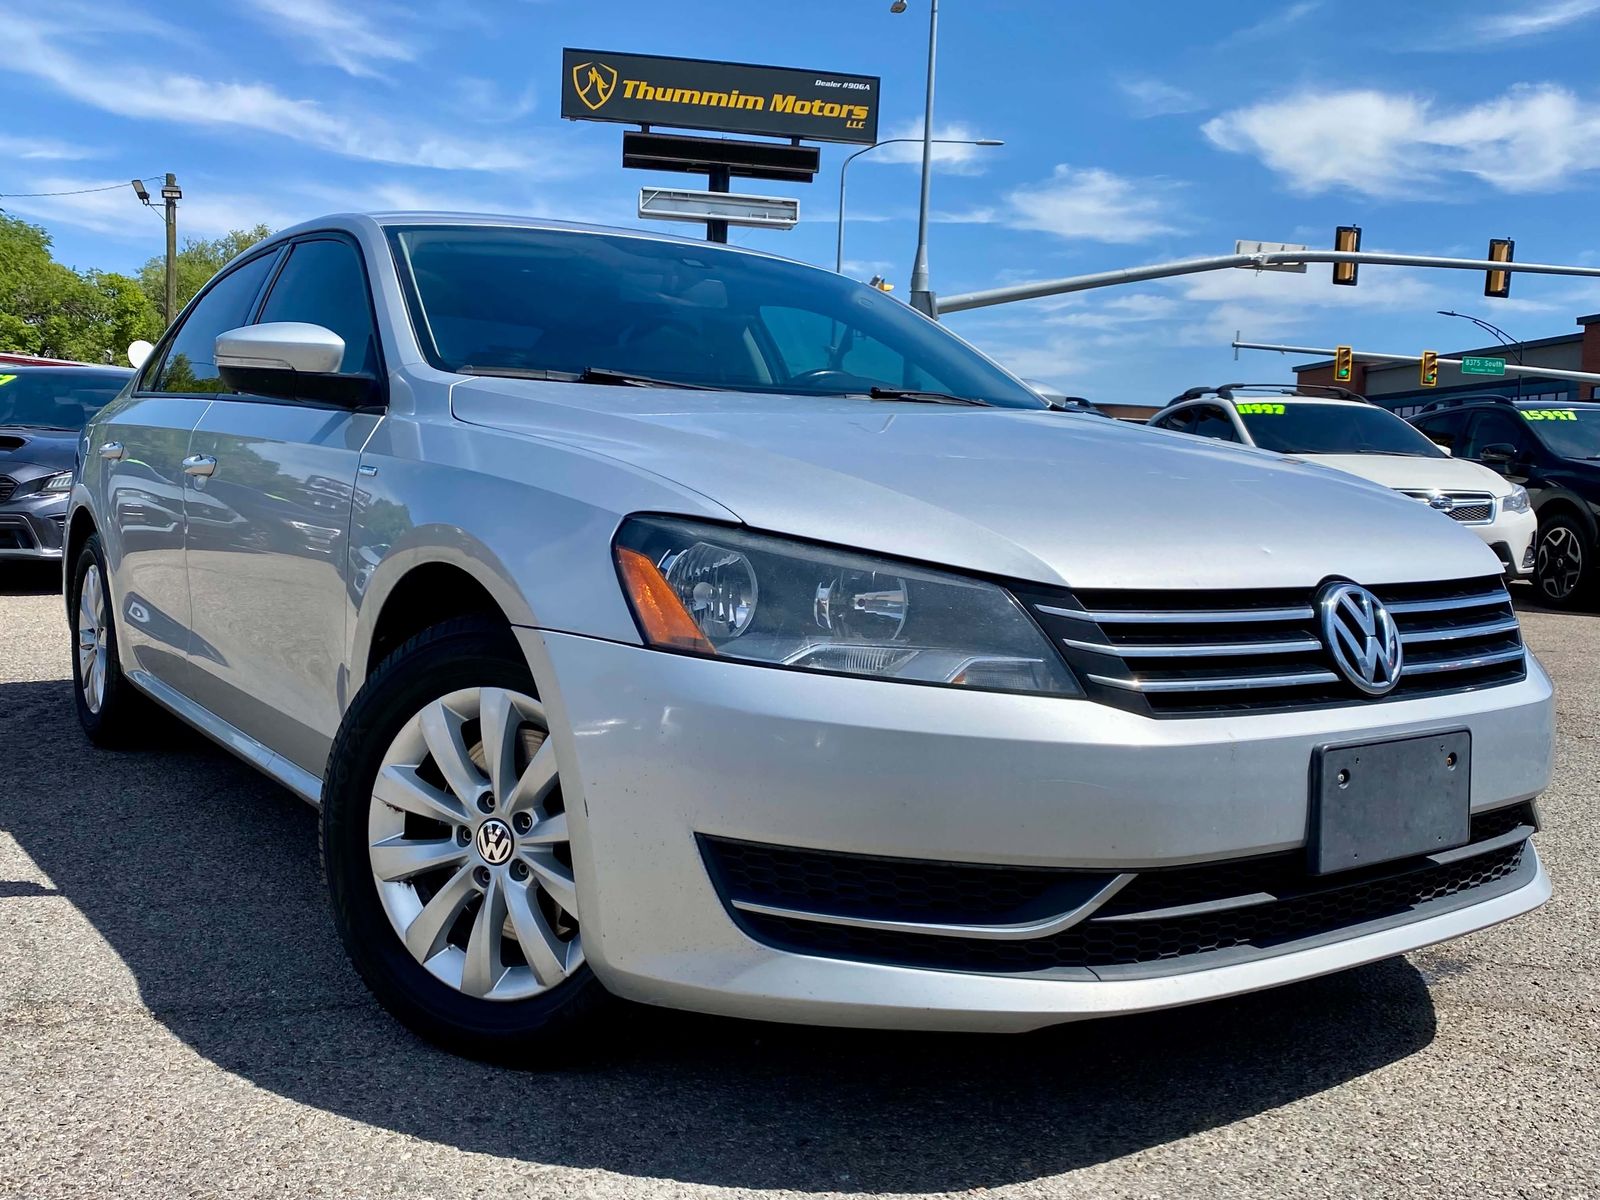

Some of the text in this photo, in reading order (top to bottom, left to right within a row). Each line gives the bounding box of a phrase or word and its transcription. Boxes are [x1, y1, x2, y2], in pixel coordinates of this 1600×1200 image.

[815, 79, 842, 88] Dealer
[623, 79, 869, 120] Thummim Motors
[846, 120, 865, 129] LLC
[1236, 404, 1285, 415] 11997
[1520, 410, 1578, 421] 15997
